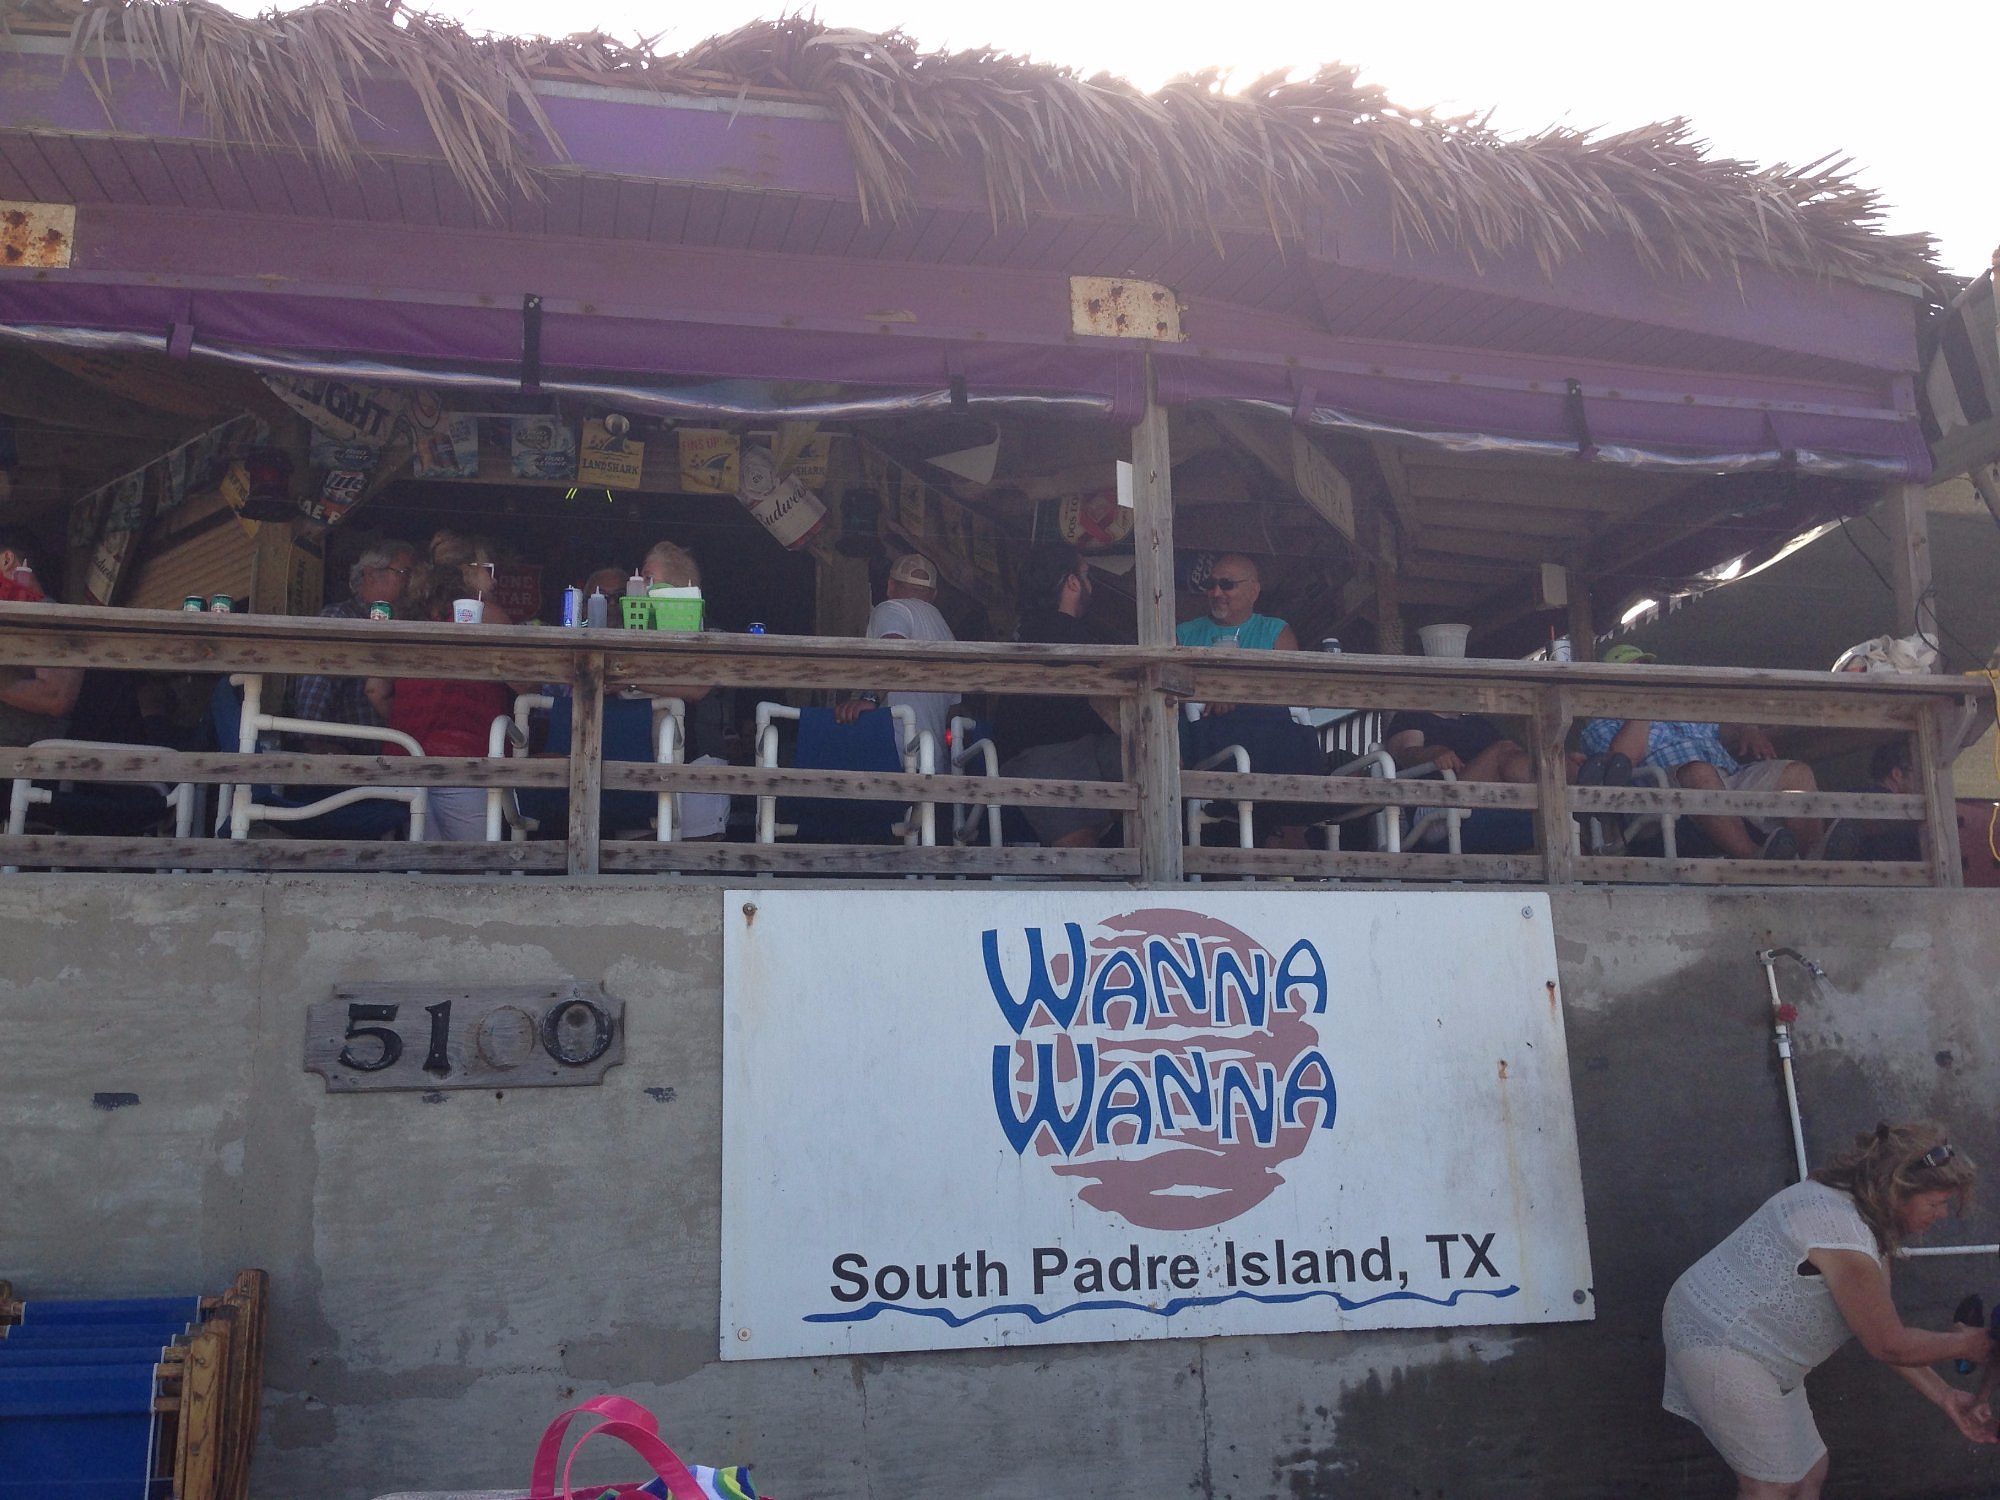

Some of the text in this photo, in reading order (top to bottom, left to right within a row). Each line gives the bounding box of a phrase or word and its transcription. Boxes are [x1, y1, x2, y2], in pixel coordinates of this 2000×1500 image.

[582, 458, 639, 475] LANDSHARK
[498, 575, 534, 589] ONE
[498, 592, 533, 605] TAR
[980, 921, 1328, 1036] WANNA
[991, 1043, 1338, 1158] WANNA
[830, 1232, 1501, 1303] South Padre Island, TX
